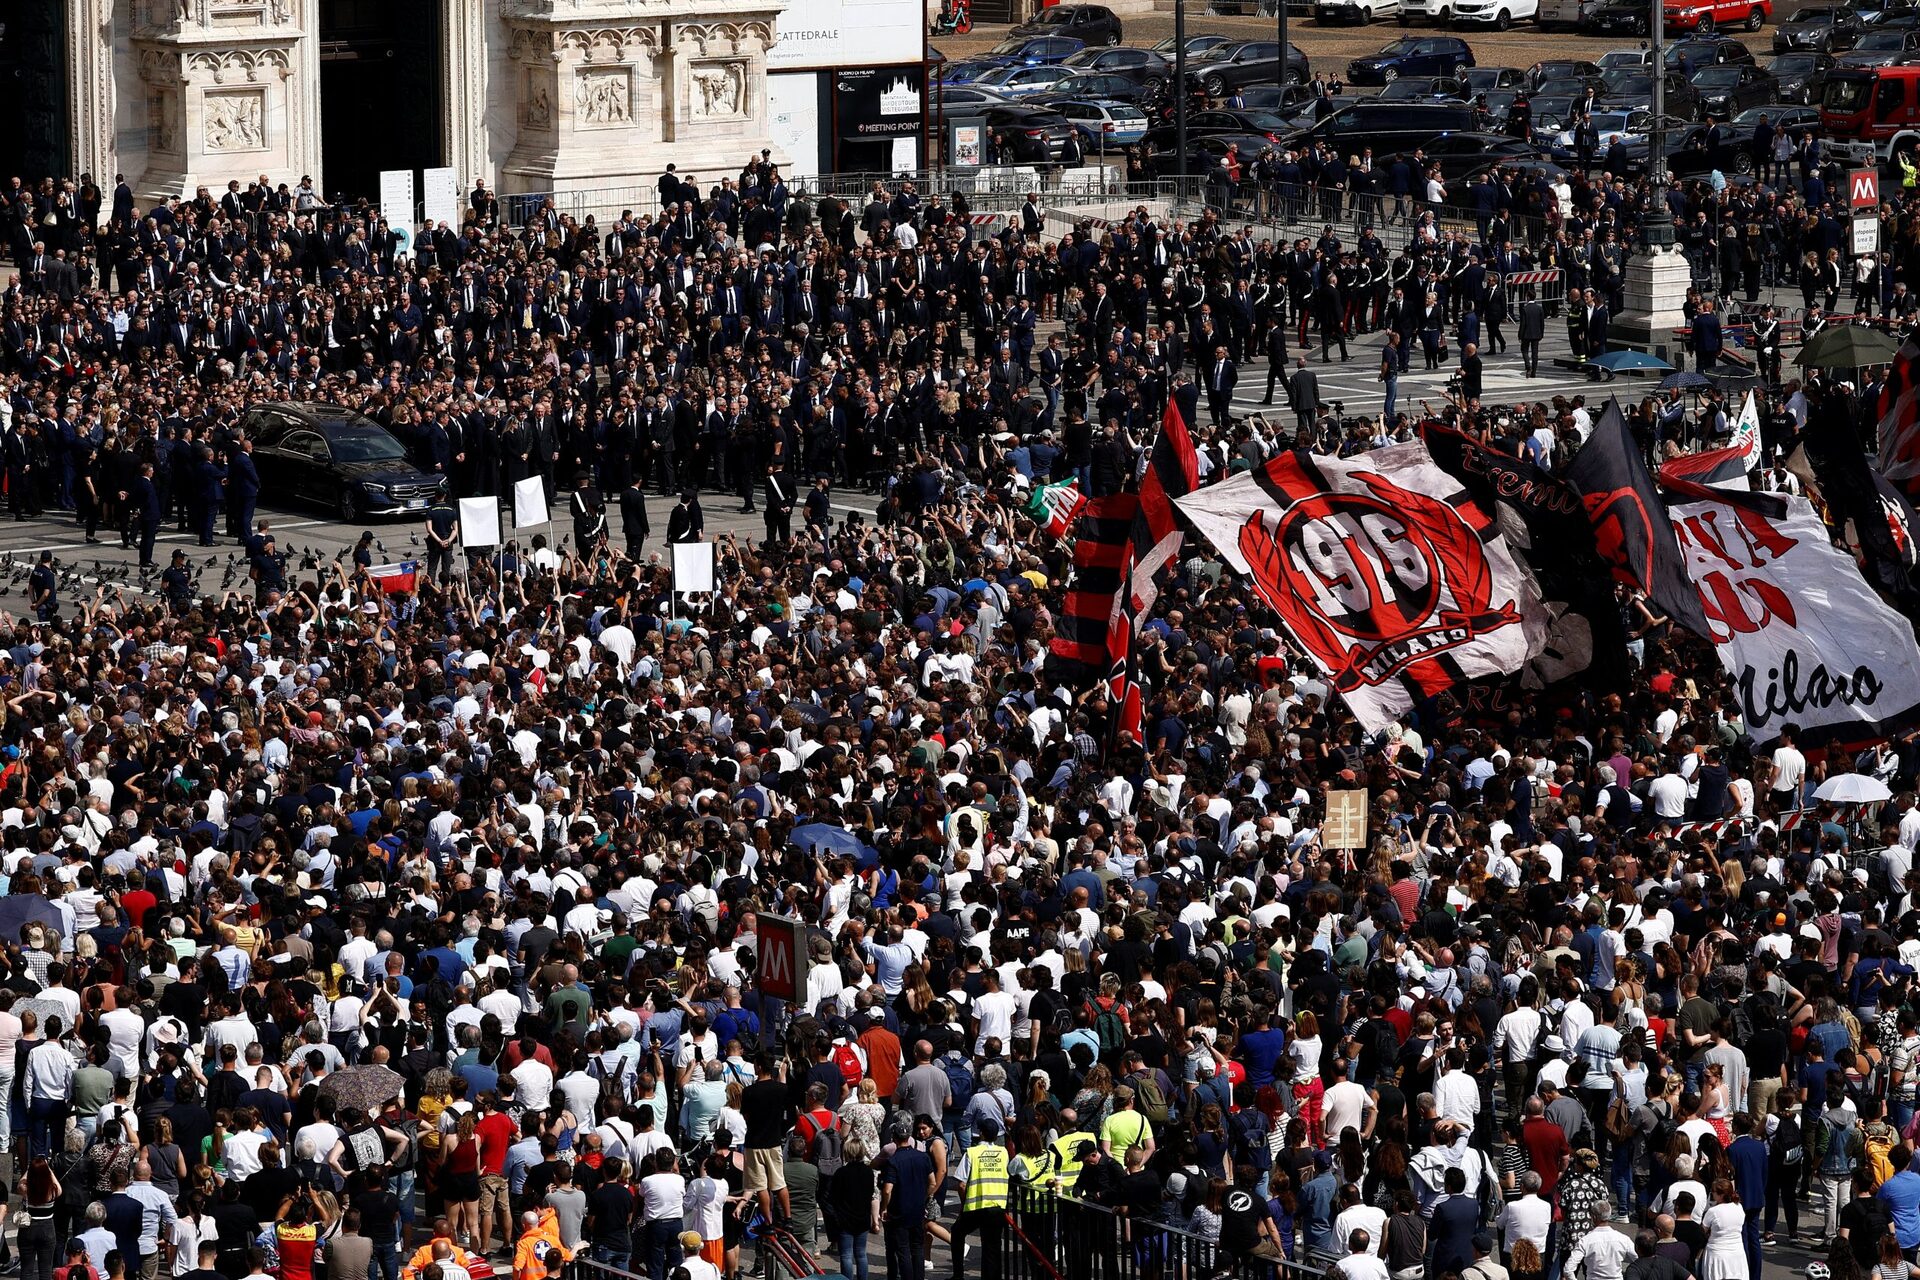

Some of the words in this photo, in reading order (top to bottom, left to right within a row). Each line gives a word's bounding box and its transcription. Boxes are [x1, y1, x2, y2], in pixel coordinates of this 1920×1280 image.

[775, 30, 838, 41] CATTEDRALE
[866, 124, 896, 132] MEETING
[898, 122, 920, 130] POINT
[1852, 177, 1875, 199] M
[1289, 511, 1429, 618] 1976
[1361, 628, 1466, 681] MILANO
[1007, 928, 1030, 938] AAPE
[761, 937, 791, 984] M
